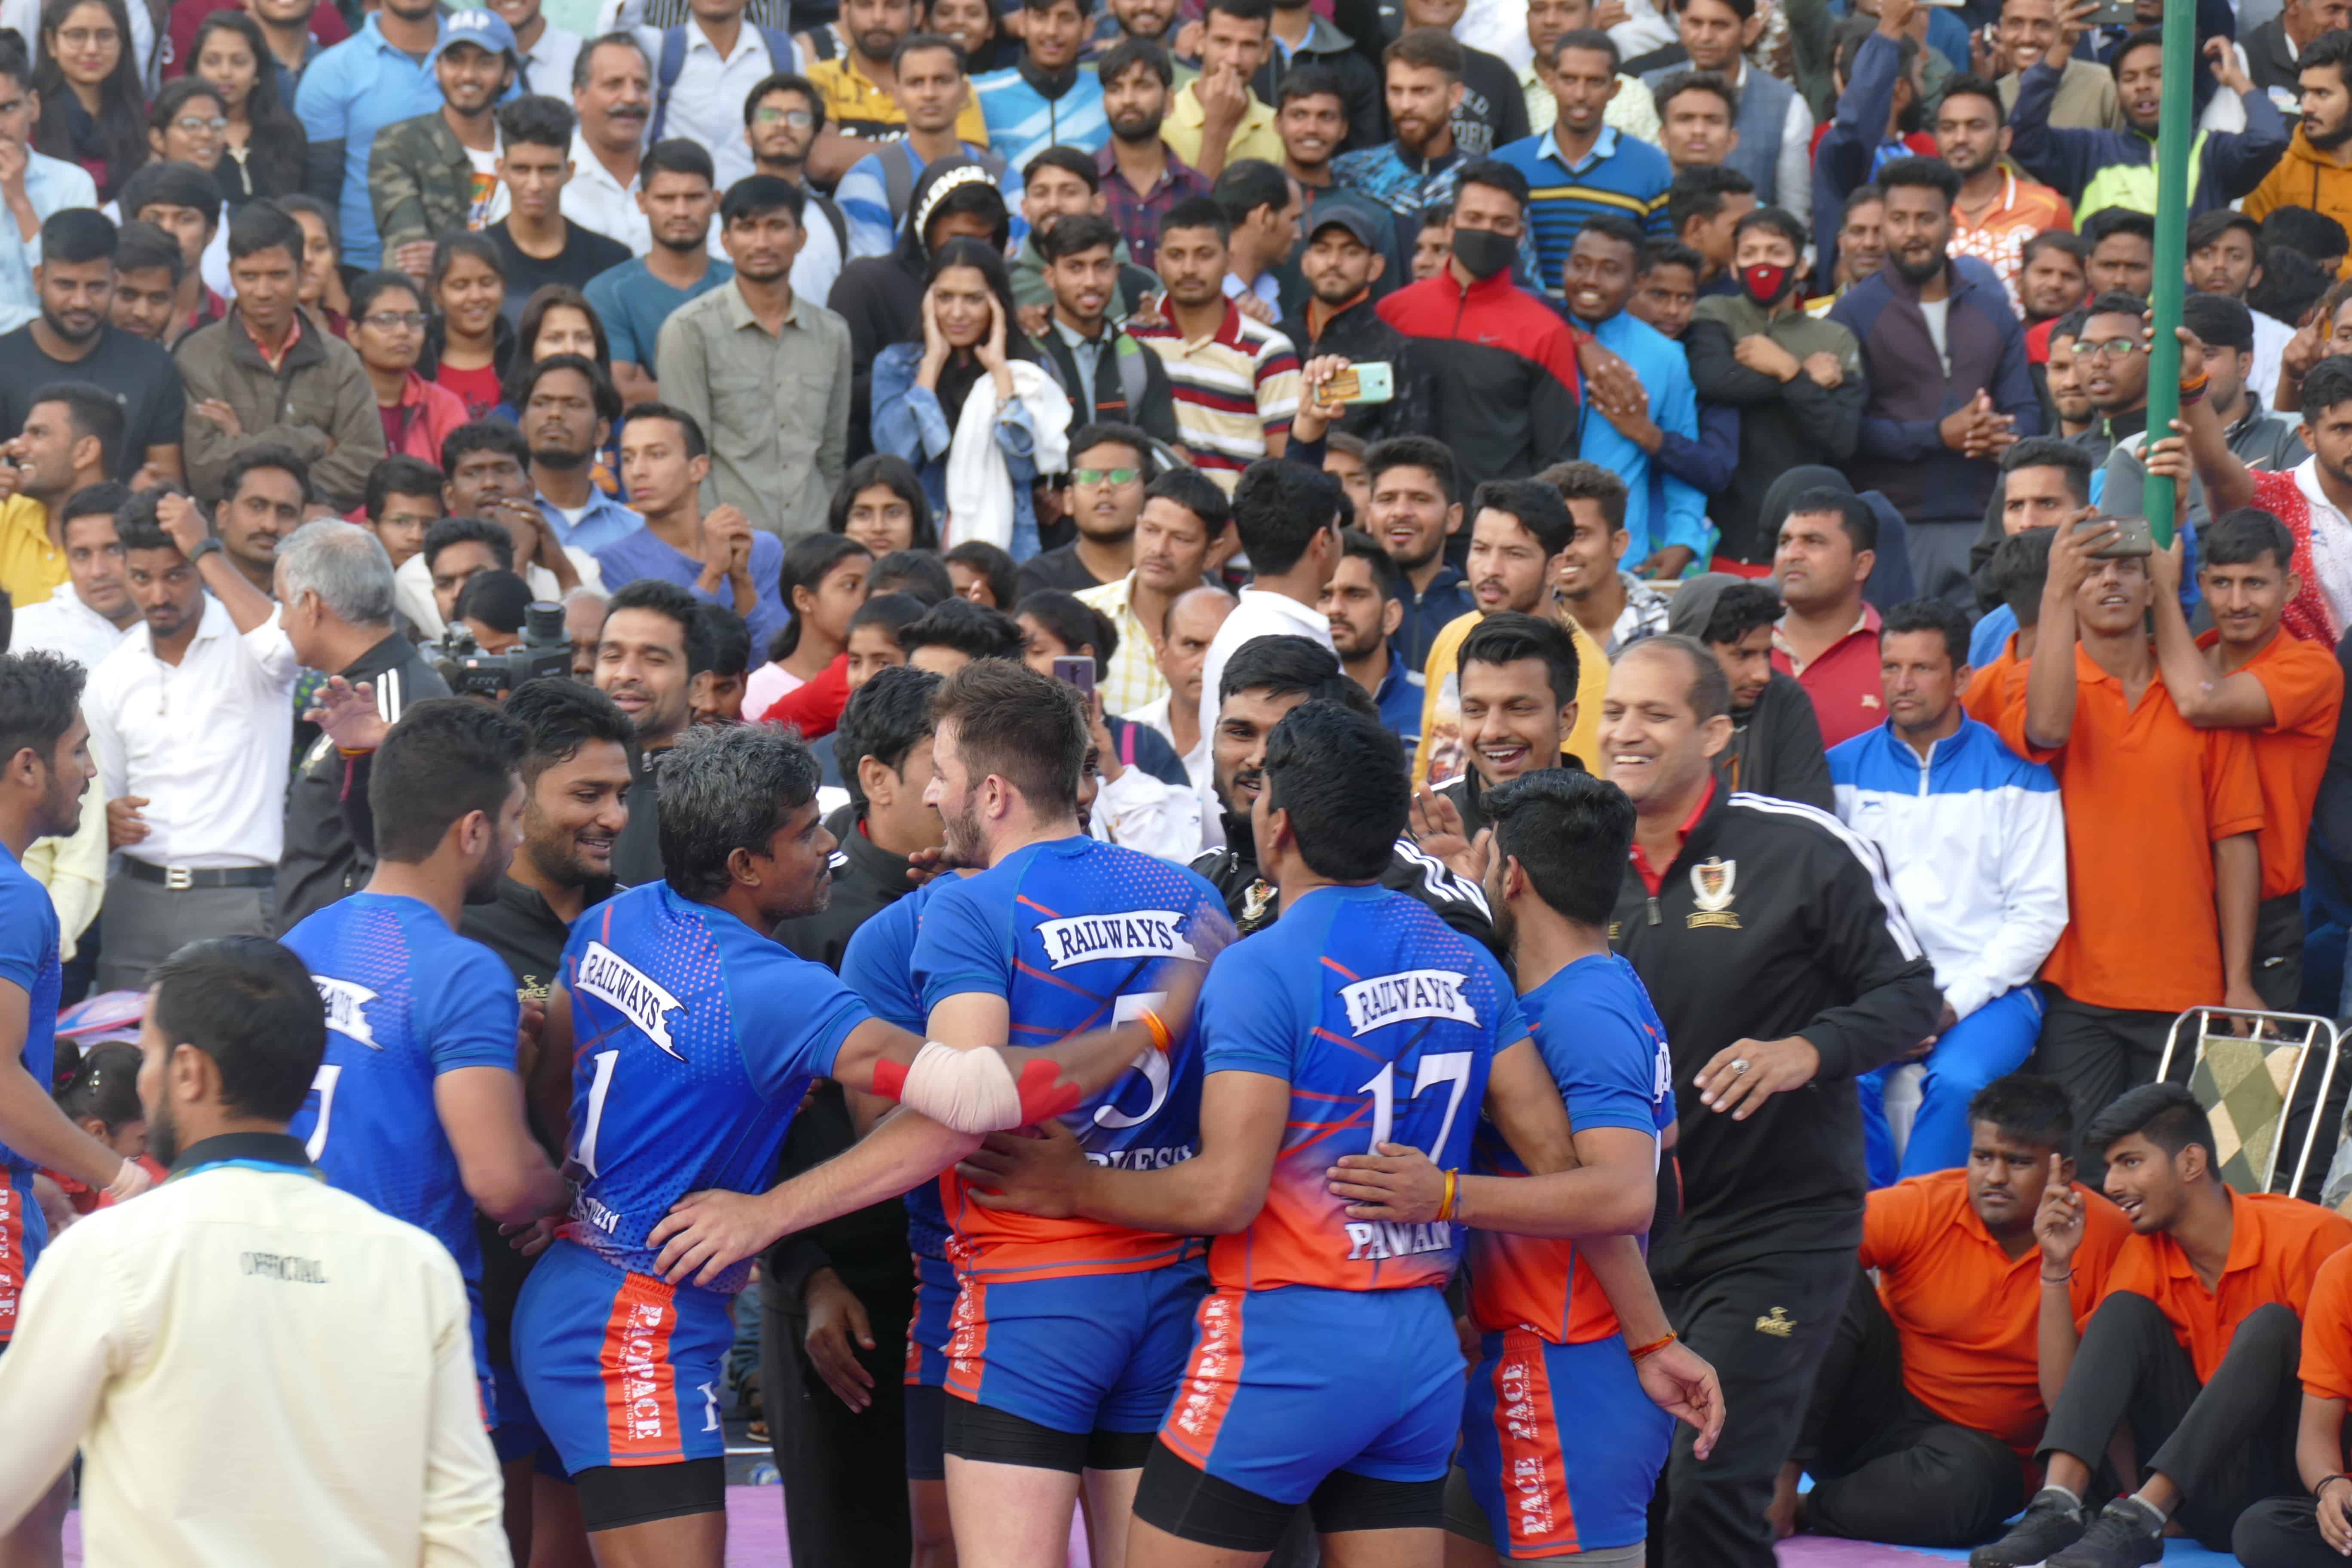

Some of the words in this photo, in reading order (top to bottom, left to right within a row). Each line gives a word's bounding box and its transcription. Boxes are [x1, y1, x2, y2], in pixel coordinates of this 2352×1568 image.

[1057, 919, 1173, 960] RAILWAYS
[584, 954, 661, 1030] RAILWAYS
[1358, 977, 1455, 1026] RAILWAYS
[1093, 991, 1170, 1129] 5
[569, 1049, 619, 1179] 1
[1342, 1051, 1474, 1199] 17
[1344, 1220, 1452, 1260] PAWAN
[627, 1363, 662, 1439] PACE
[697, 1381, 720, 1432] 1
[1502, 1363, 1531, 1440] PACE
[1514, 1458, 1548, 1535] PACE
